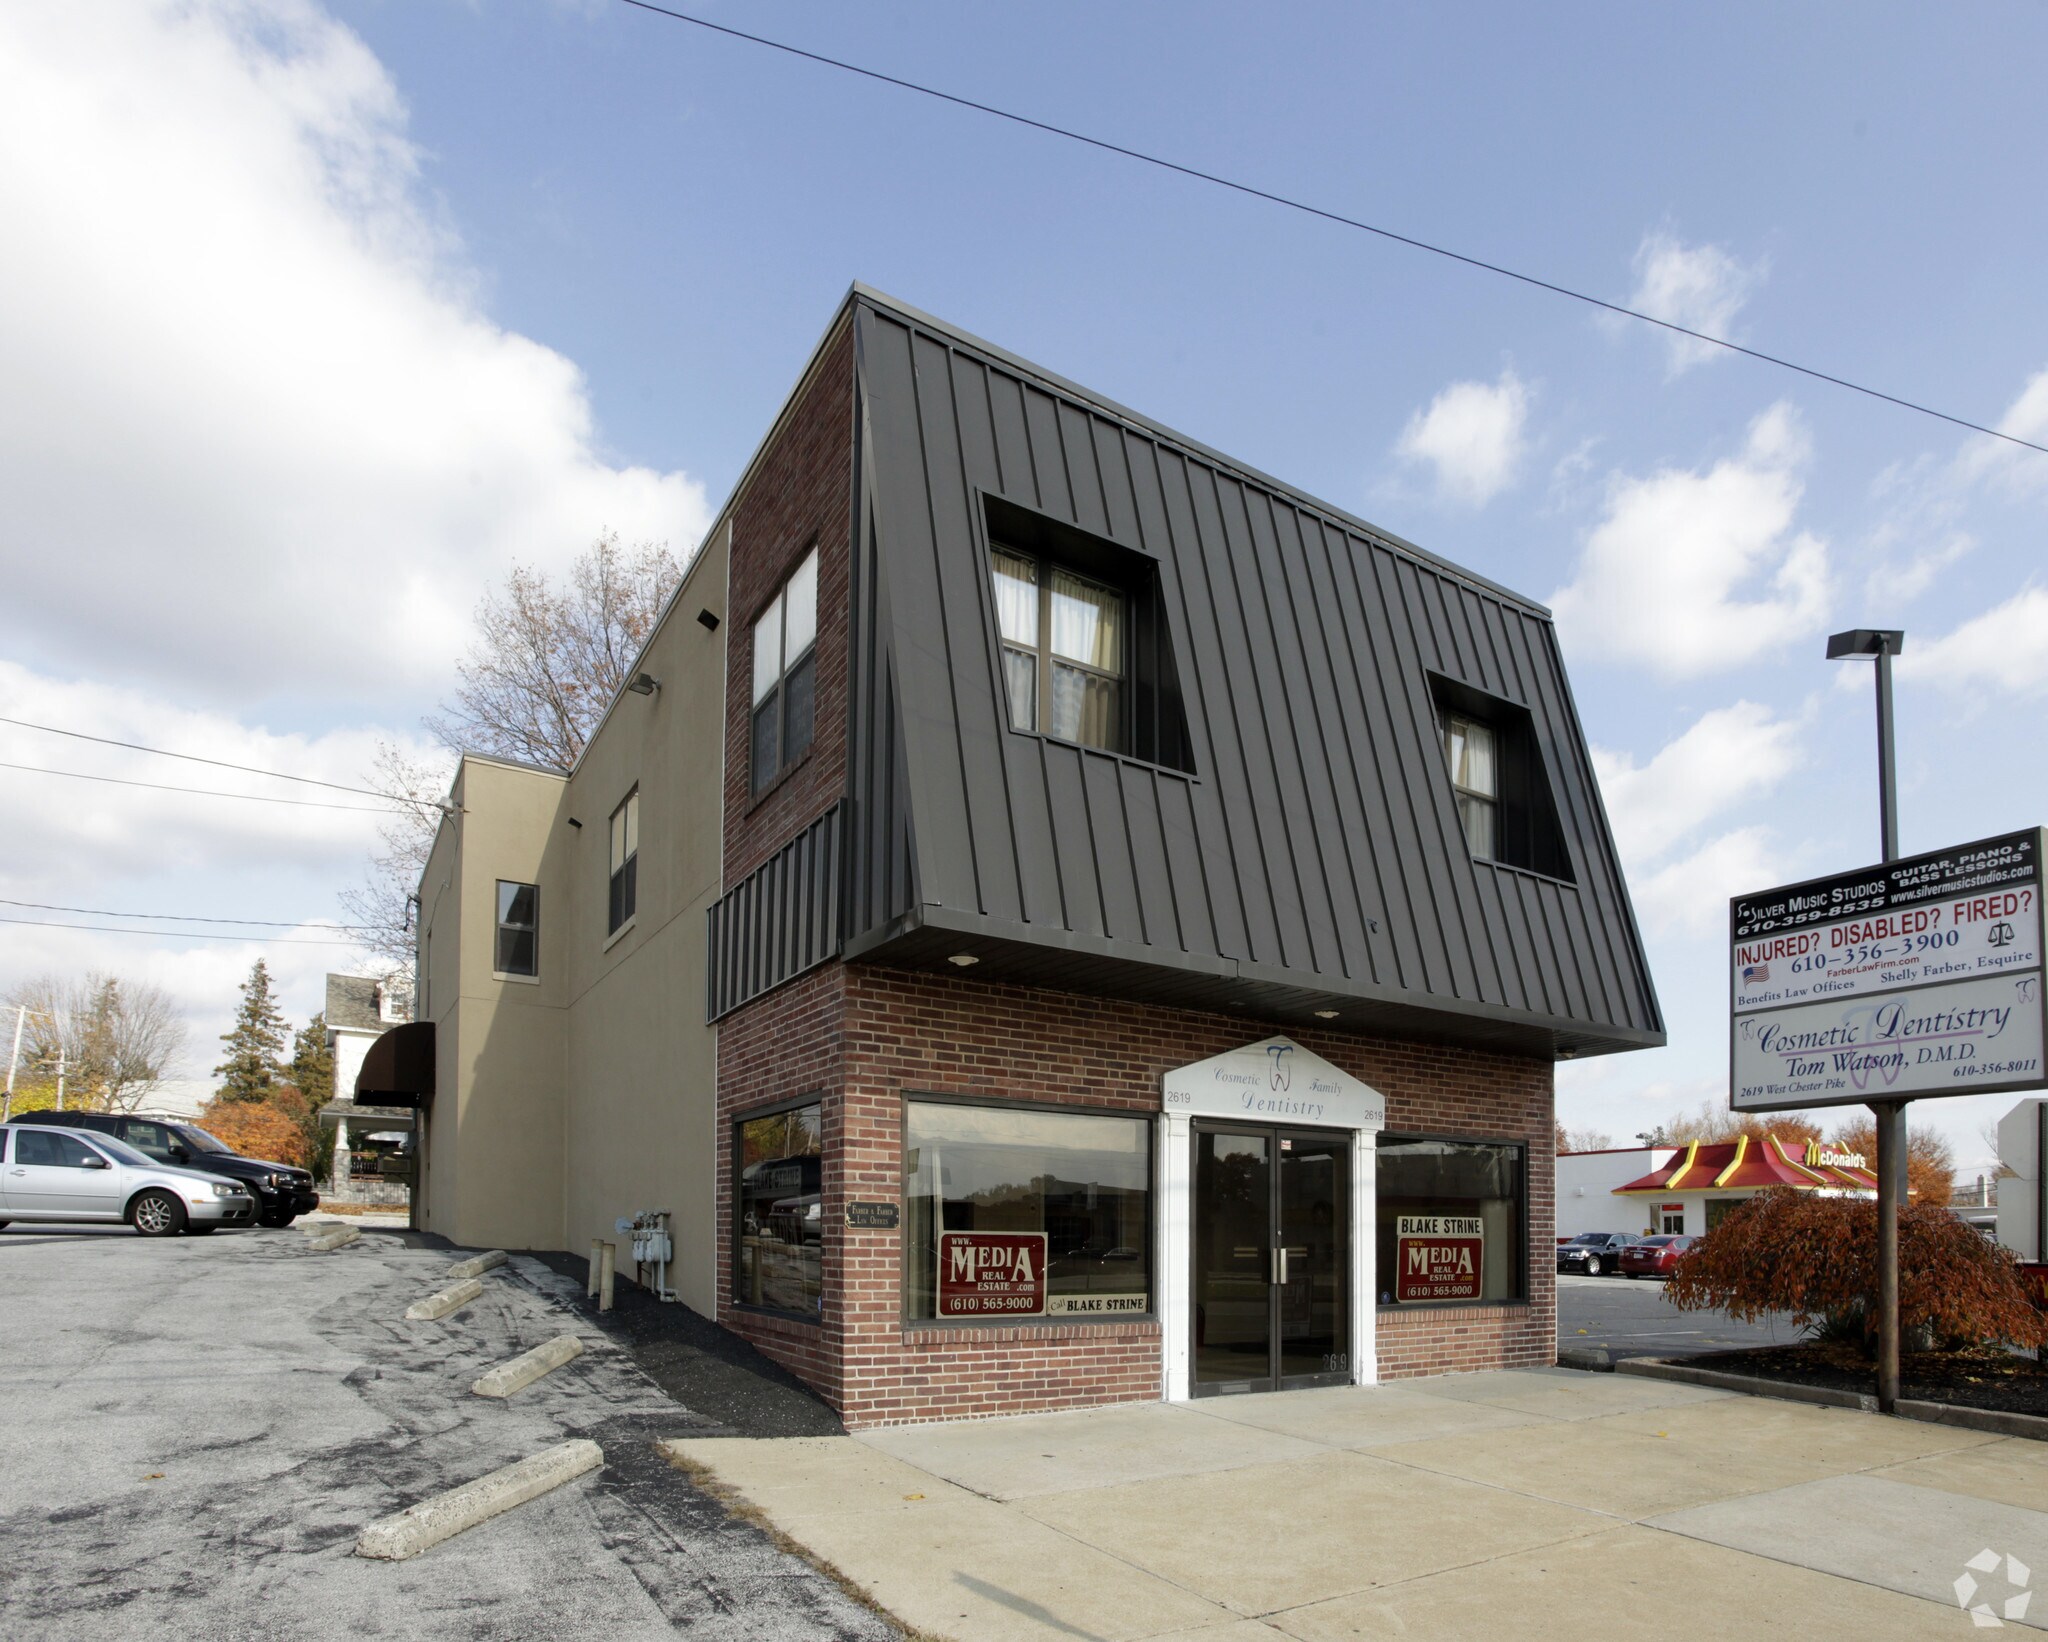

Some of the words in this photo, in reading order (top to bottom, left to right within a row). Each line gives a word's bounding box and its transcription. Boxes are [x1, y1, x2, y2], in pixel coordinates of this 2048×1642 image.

[1891, 860, 1955, 880] GUITAR,
[1960, 846, 2013, 864] PIANO
[2018, 841, 2032, 851] &
[1900, 873, 1941, 887] BASS
[1945, 853, 2023, 877] LESSONS
[1789, 893, 1828, 913] MUSIC
[1832, 880, 1886, 902] STUDIOS
[1891, 865, 2034, 904] www.silvermusicstudios.com
[1736, 932, 1820, 966] INJURED?
[1831, 908, 1941, 948] DISABLED?
[1954, 890, 2032, 925] FIRED?
[1737, 897, 1885, 936] 610-359-8535
[1791, 930, 1960, 974] 610-356-3900
[1827, 955, 1920, 978] FarberLawFirm.com
[1881, 969, 1918, 984] Shelly
[1923, 962, 1972, 977] Farber,
[1977, 951, 2033, 969] Esquire
[1738, 993, 1781, 1006] Benefits
[1785, 988, 1809, 998] Law
[1813, 981, 1855, 993] Offices
[1757, 1023, 1860, 1053] Cosmetic
[1876, 1002, 2012, 1039] Dentistry
[1786, 1057, 1825, 1078] Tom
[1832, 1051, 1910, 1073] Watson,
[1917, 1043, 1976, 1064] D.M.D.
[1953, 1059, 2037, 1078] 610-356-8011
[1213, 1066, 1261, 1086] Cosmetic
[1309, 1078, 1343, 1097] Family
[1740, 1086, 1763, 1097] 2619
[1766, 1083, 1786, 1094] West
[1788, 1080, 1822, 1093] Chester
[1825, 1078, 1846, 1090] Pike
[1167, 1091, 1191, 1104] 2619
[1241, 1090, 1324, 1120] Dentistry
[1364, 1110, 1383, 1121] 2619
[1806, 1143, 1866, 1168] McDonald's
[1401, 1218, 1438, 1234] BLAKE
[1443, 1219, 1481, 1234] STRINE
[950, 1247, 1035, 1282] MEDIA
[1407, 1247, 1474, 1275] MEDIA
[1433, 1266, 1452, 1274] REAL
[977, 1282, 1010, 1291] ESTATE
[1016, 1283, 1035, 1292] .com
[982, 1271, 1006, 1281] REAL
[1429, 1274, 1456, 1282] ESTATE
[1460, 1274, 1473, 1282] .com
[1407, 1286, 1430, 1297] (610)
[1433, 1285, 1472, 1296] 565-9000
[950, 1297, 979, 1311] (610)
[982, 1297, 1033, 1310] 565-9000
[1050, 1298, 1066, 1312] Call
[1067, 1300, 1102, 1312] BLAKE
[1106, 1298, 1144, 1310] STRINE
